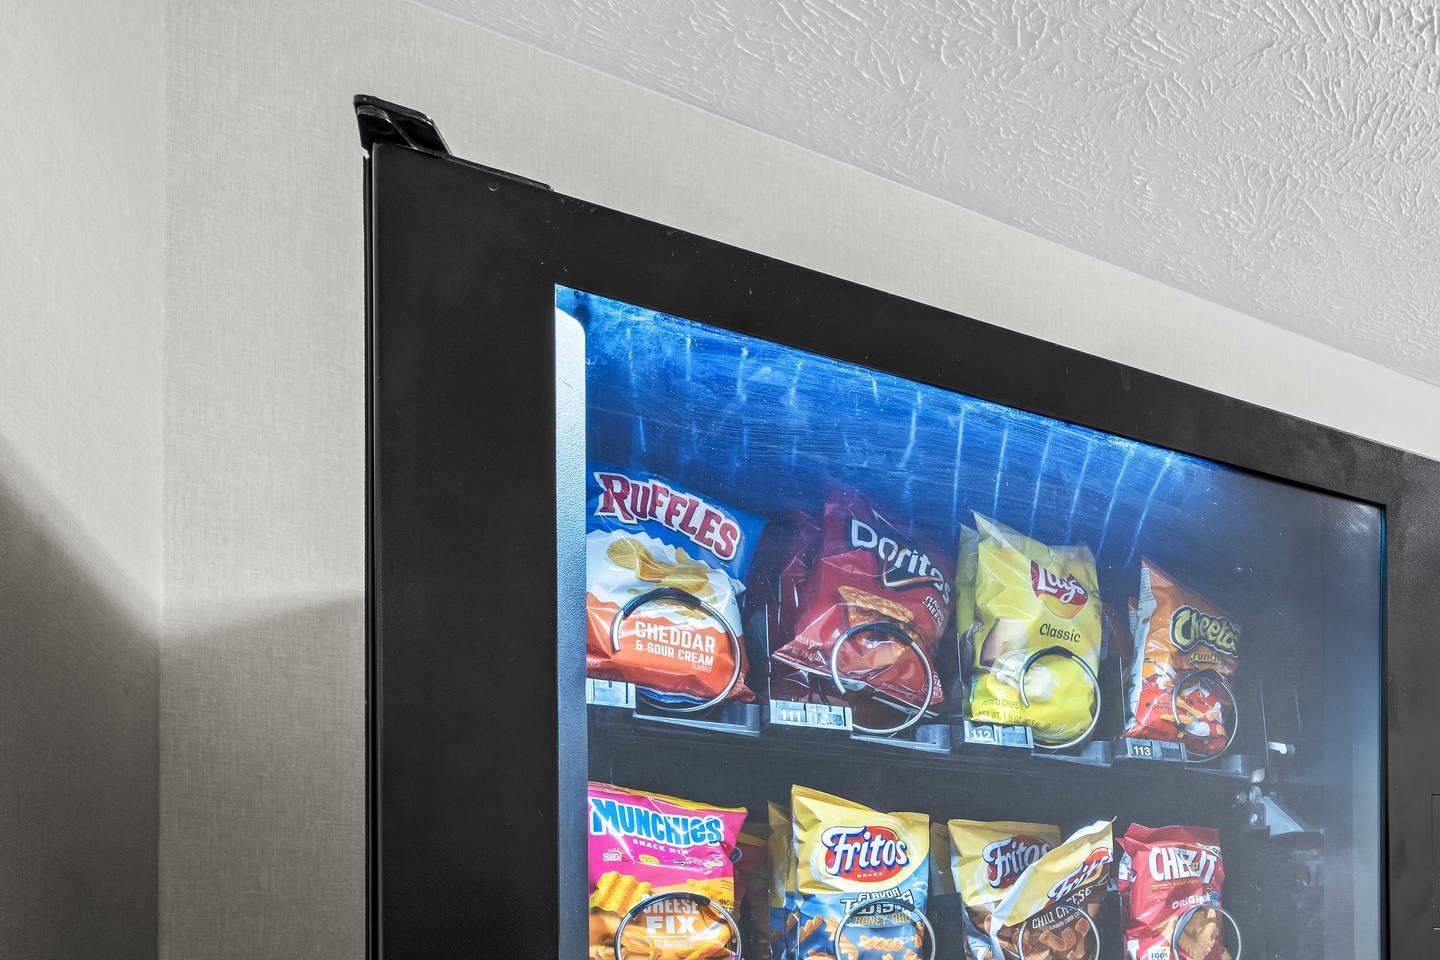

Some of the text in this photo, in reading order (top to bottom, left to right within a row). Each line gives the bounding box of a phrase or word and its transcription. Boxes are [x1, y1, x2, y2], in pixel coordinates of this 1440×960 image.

[596, 473, 740, 559] RUFFLES
[850, 518, 952, 605] Doritos
[1037, 566, 1087, 604] Lay's
[634, 621, 716, 655] CHEDDAR
[1039, 623, 1081, 643] Classic
[635, 640, 714, 668] & SOUR CREAM
[970, 729, 992, 740] 112
[1133, 745, 1152, 756] 113
[590, 799, 724, 847] MUNCHIES
[633, 838, 666, 852] SNACK
[820, 825, 909, 876] Fritos
[857, 888, 901, 904] FLAVOR
[645, 916, 698, 936] FIX
[854, 914, 888, 926] HONEY
[1031, 911, 1055, 929] CHILI
